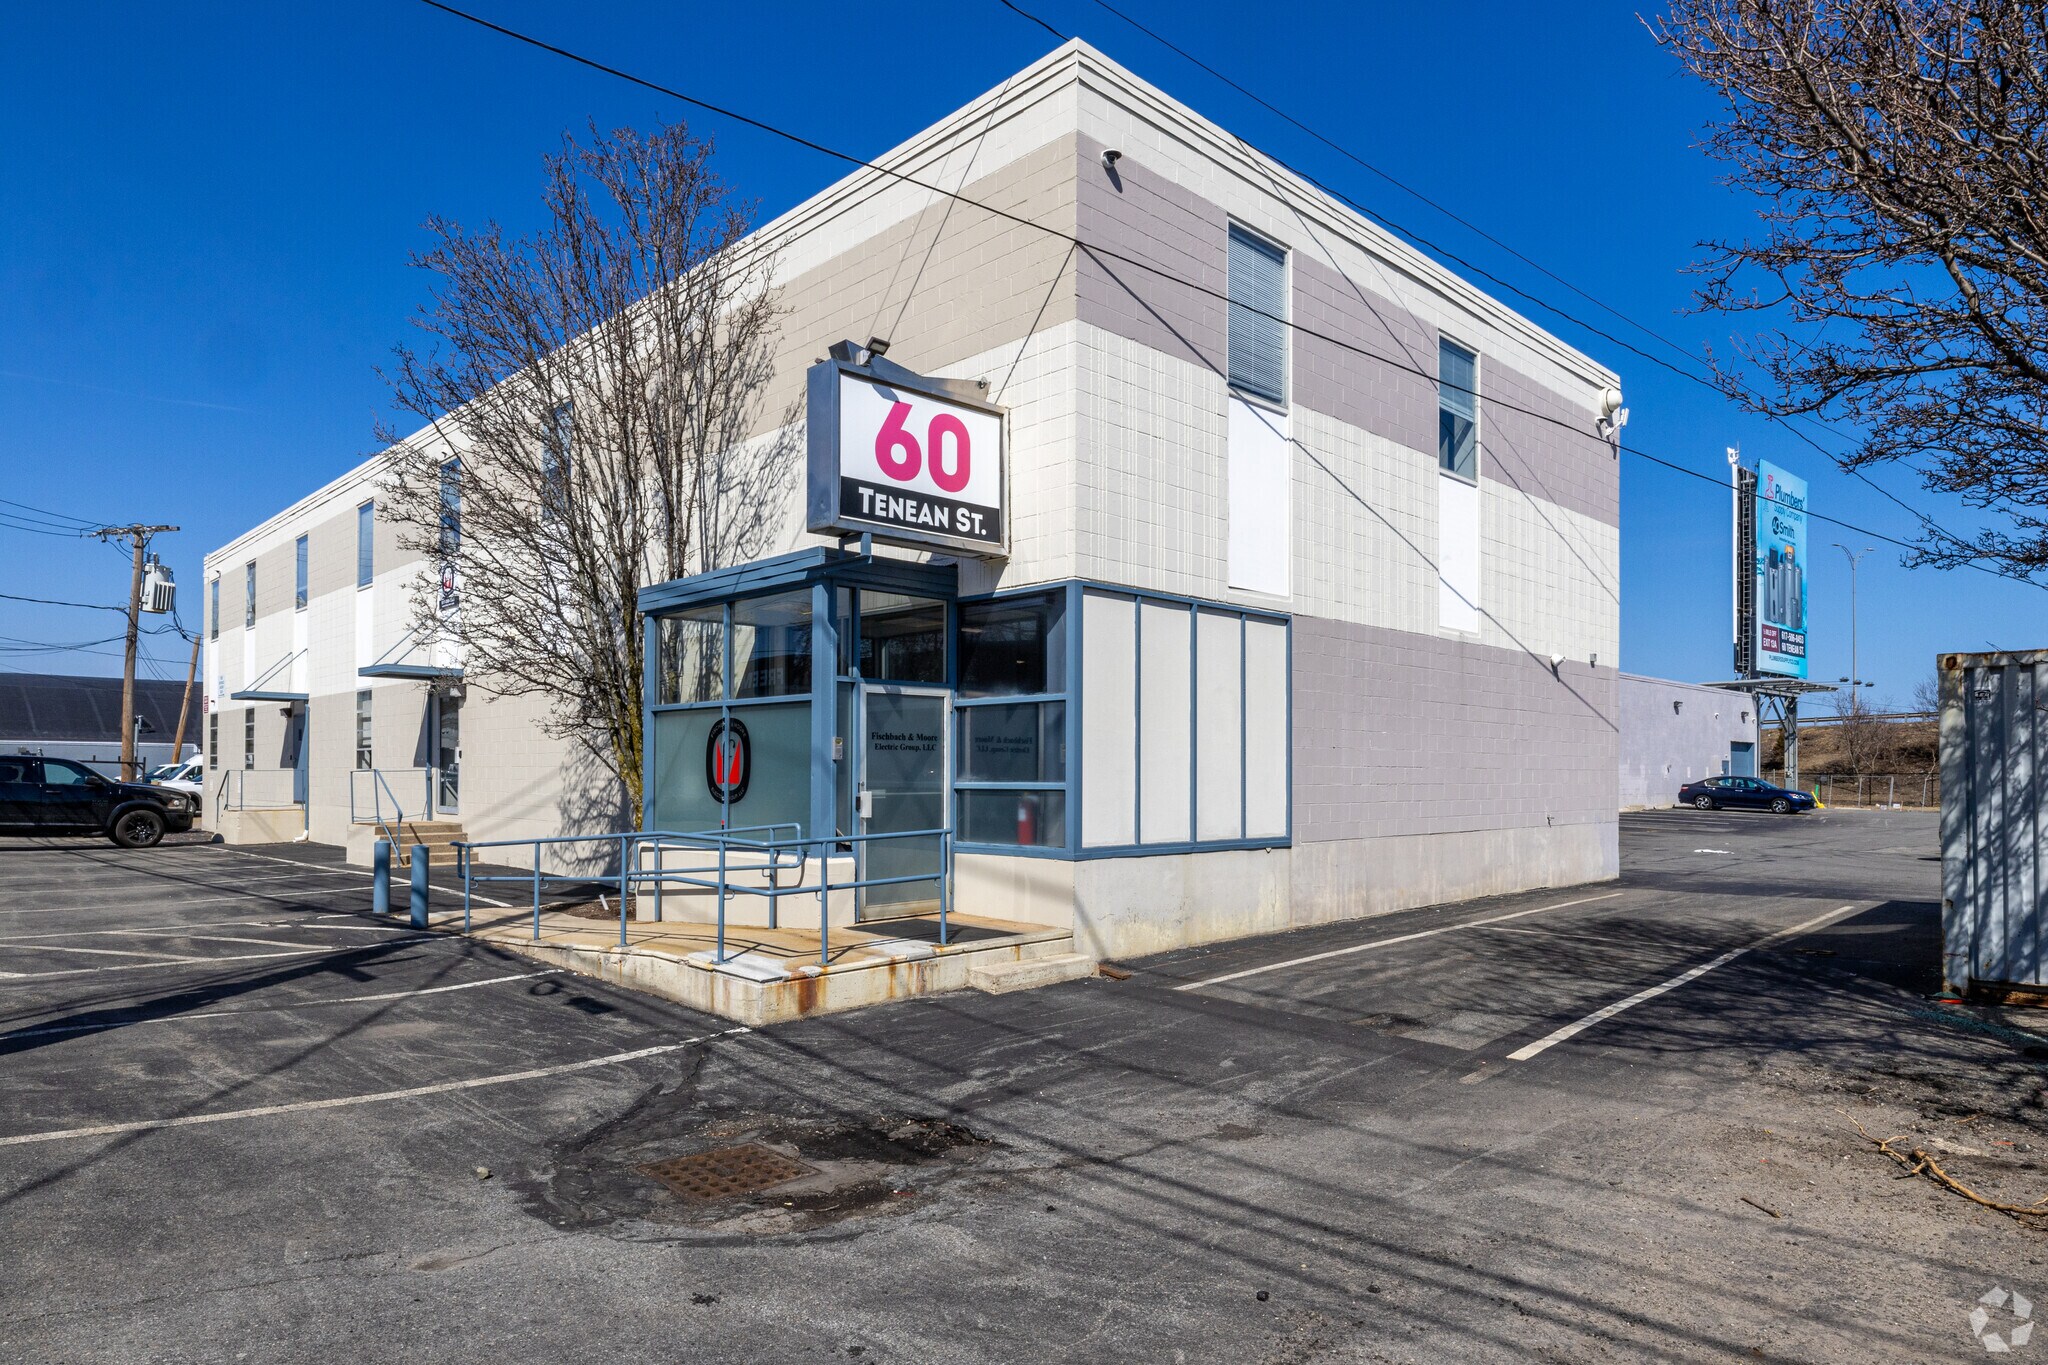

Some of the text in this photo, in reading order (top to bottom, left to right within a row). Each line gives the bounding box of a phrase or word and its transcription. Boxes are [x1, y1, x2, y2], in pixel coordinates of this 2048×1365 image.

[875, 401, 971, 493] 60
[1775, 484, 1805, 510] Plumbers'
[858, 486, 987, 536] TENEAN ST.
[1787, 644, 1799, 654] TENEAN
[872, 732, 938, 742] Fischbach & Moore
[874, 743, 898, 751] Electric
